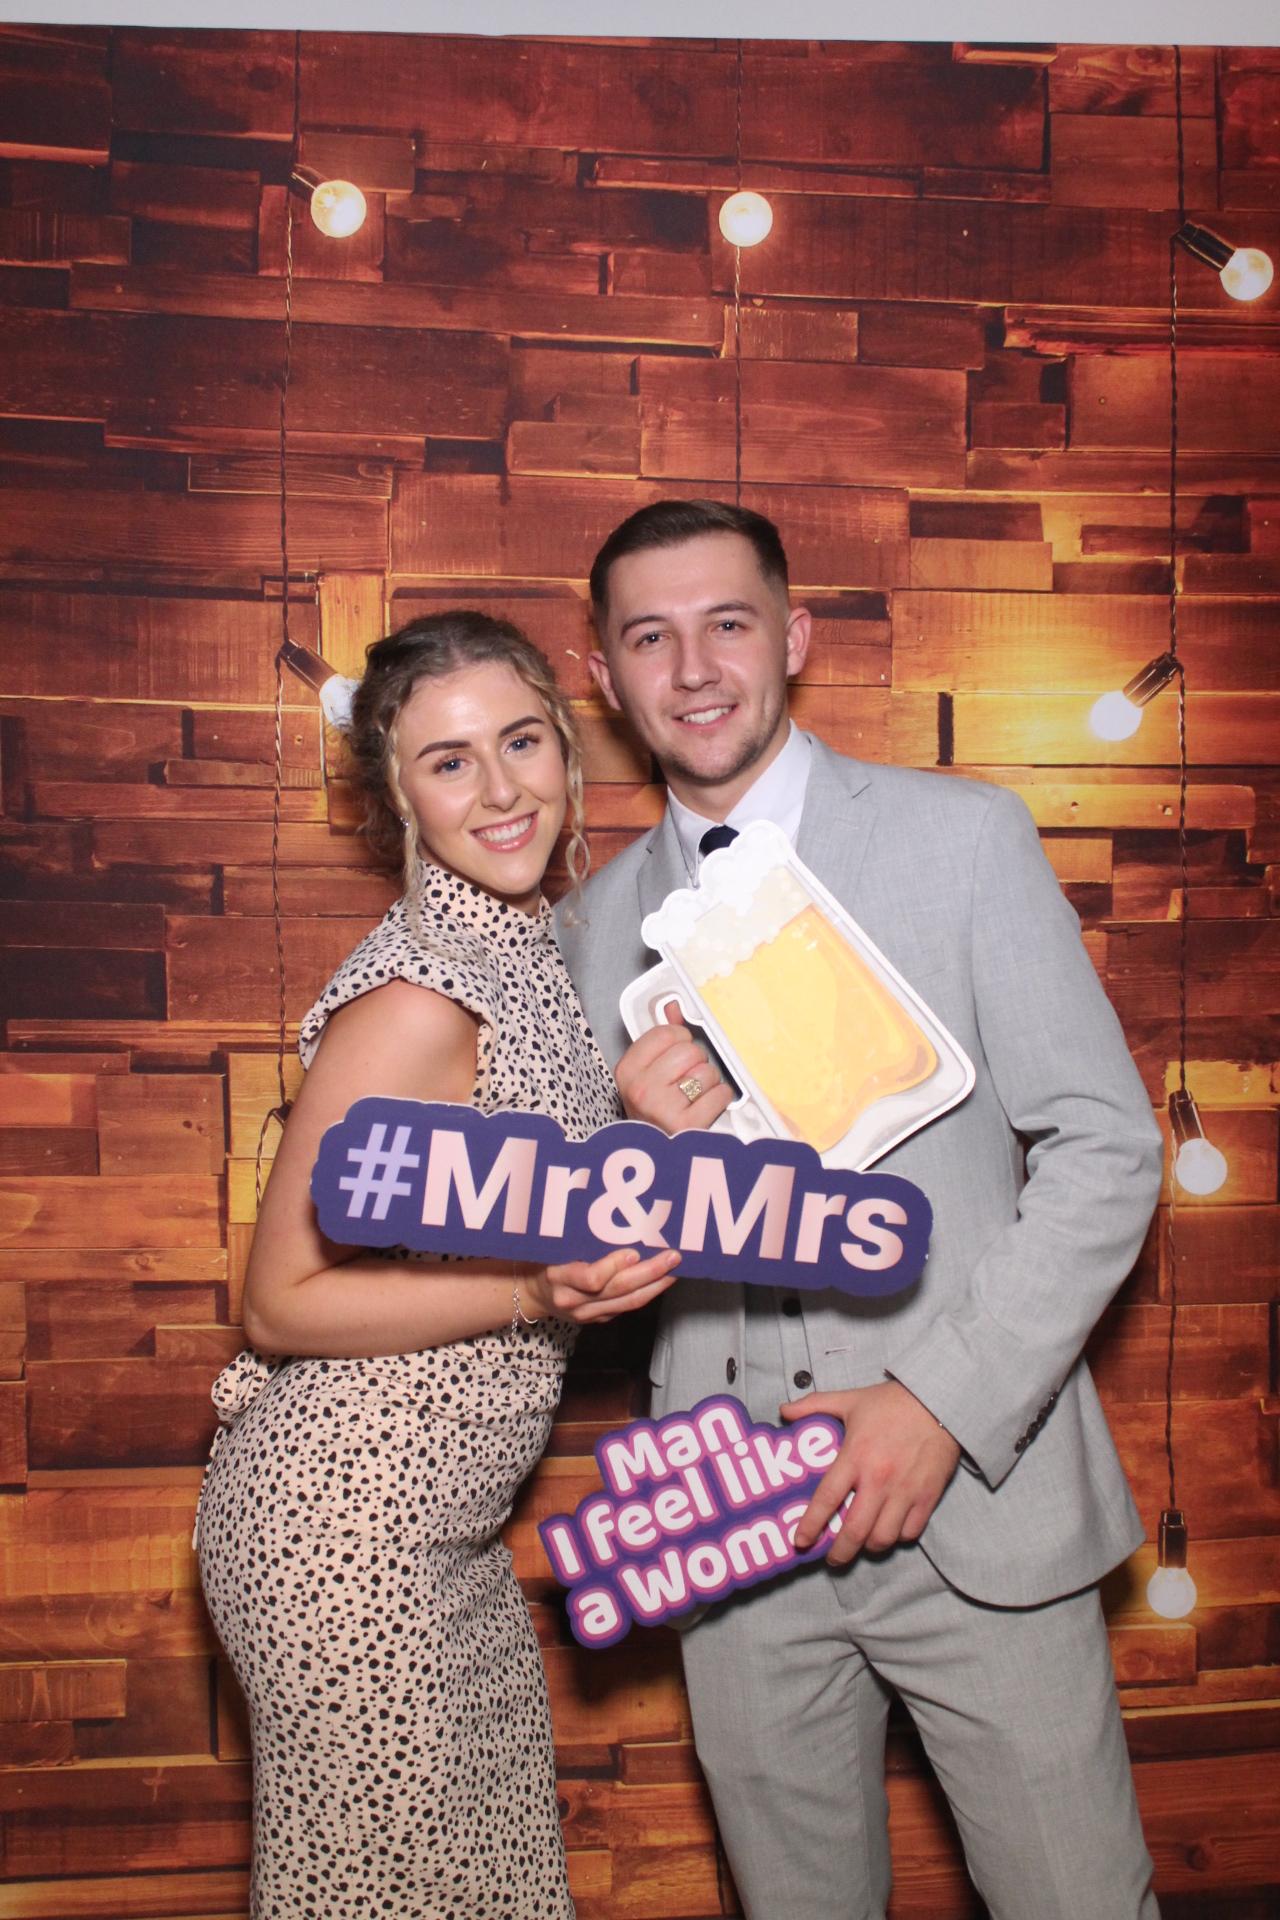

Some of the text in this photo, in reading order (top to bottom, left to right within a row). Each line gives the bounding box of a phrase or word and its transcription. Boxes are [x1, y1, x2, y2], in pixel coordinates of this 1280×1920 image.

[338, 1123, 909, 1272] #Mr&Mrs
[551, 1426, 838, 1575] I feel like
[606, 1407, 743, 1492] Man
[578, 1490, 855, 1635] a Wom
